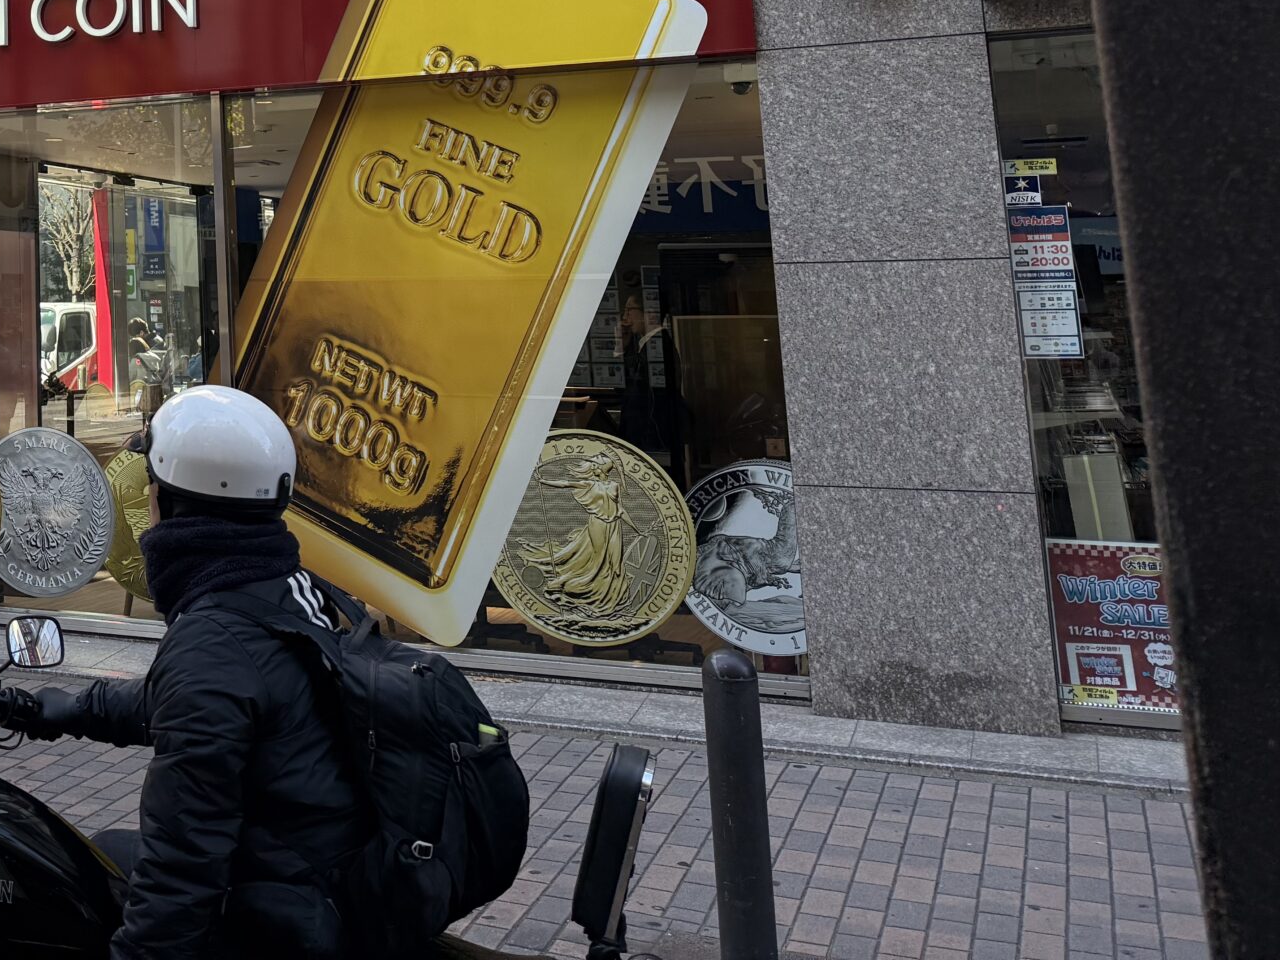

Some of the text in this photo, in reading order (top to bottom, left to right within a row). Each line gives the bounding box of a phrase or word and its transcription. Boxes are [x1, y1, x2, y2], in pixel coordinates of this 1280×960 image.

[422, 45, 560, 124] 999.9
[415, 117, 521, 184] FINE
[354, 149, 543, 264] GOLD
[1030, 256, 1070, 267] 20:00
[1032, 244, 1069, 255] 11:30
[310, 337, 439, 422] NET WT
[14, 436, 70, 455] 5 MARK
[286, 378, 428, 497] 1000g
[7, 562, 82, 588] GERMANIA
[1057, 573, 1161, 604] Winter
[647, 573, 679, 615] GOLD
[1099, 602, 1170, 628] SALE
